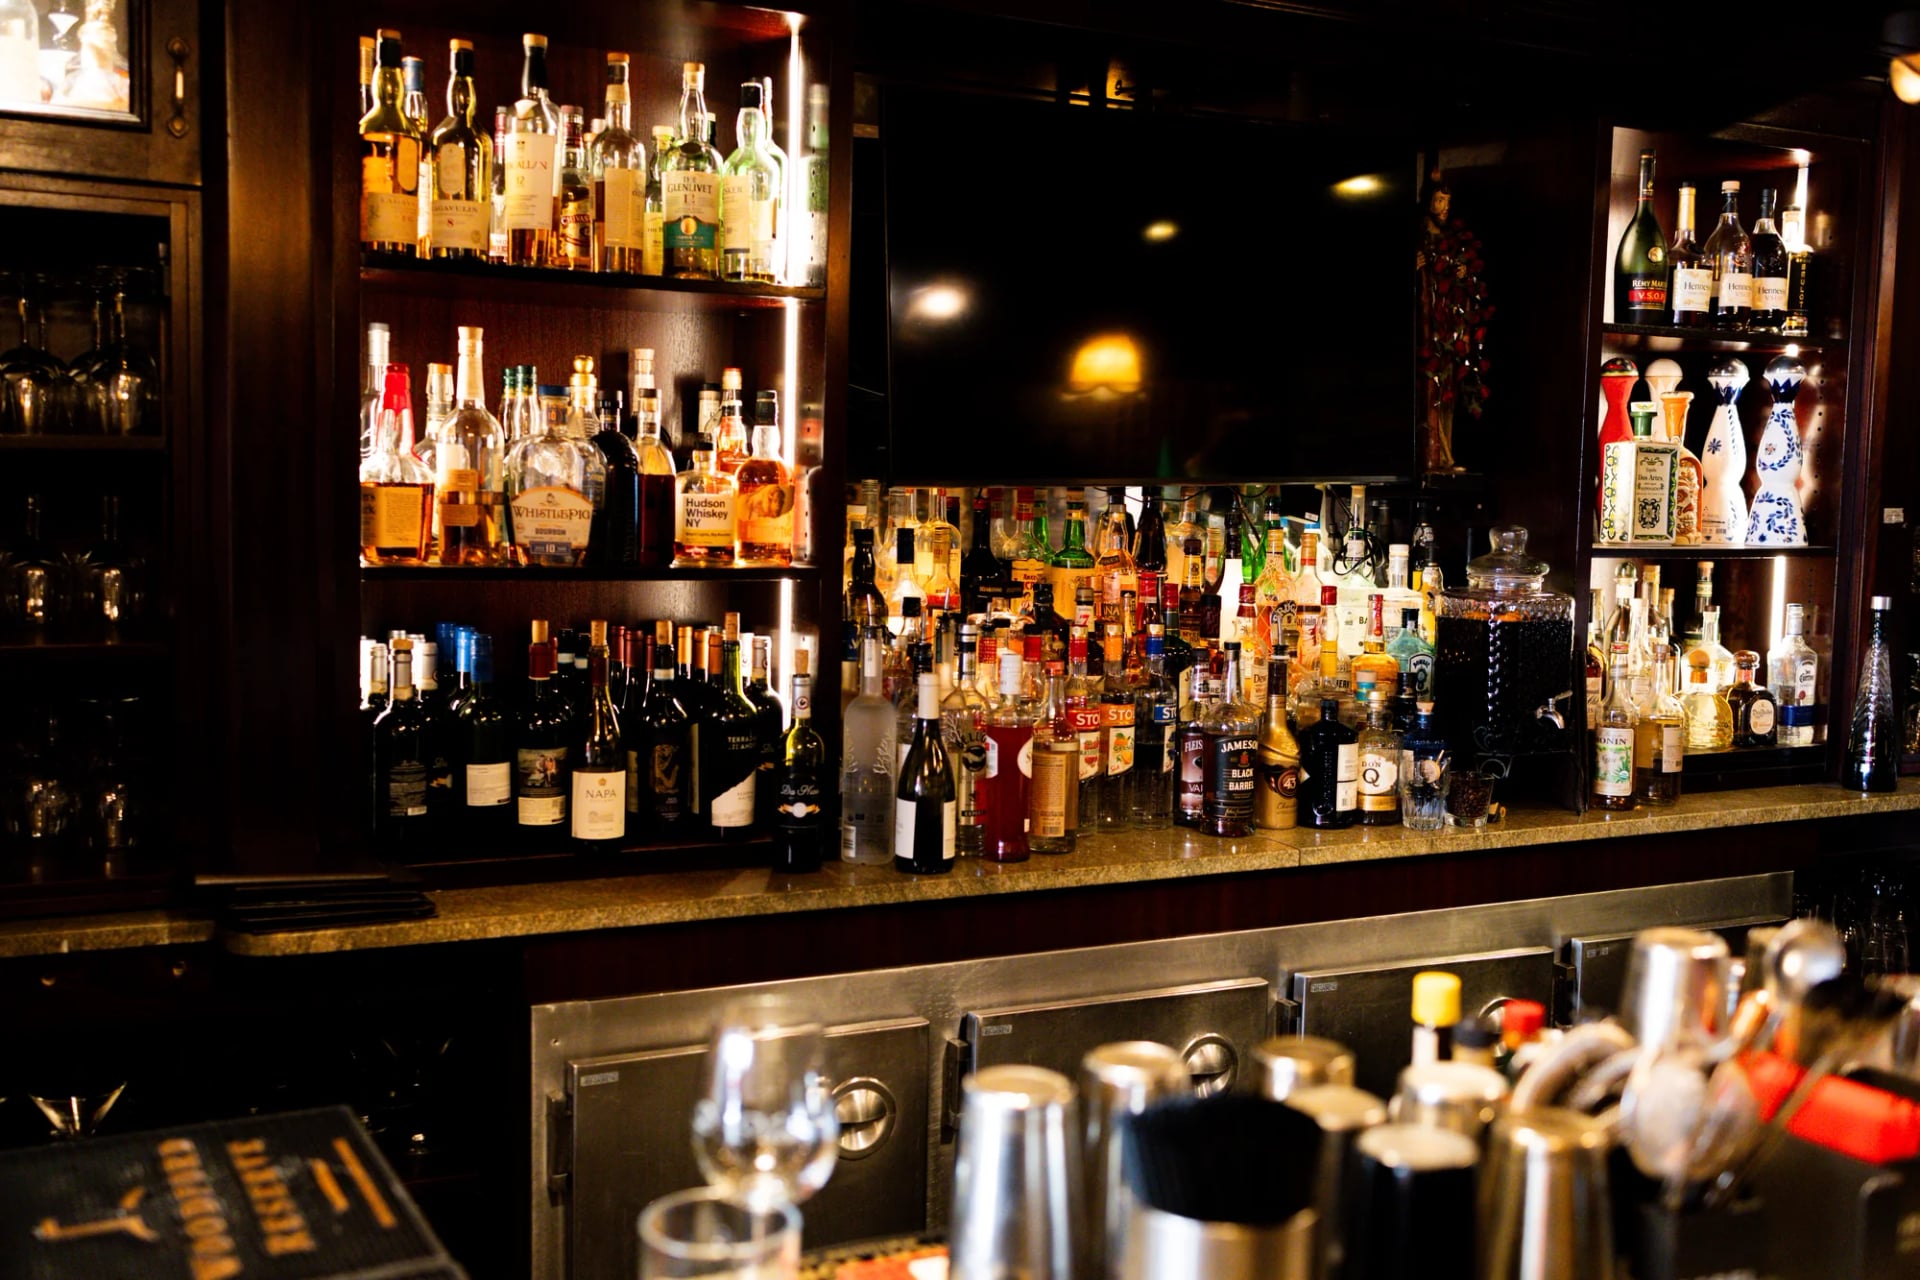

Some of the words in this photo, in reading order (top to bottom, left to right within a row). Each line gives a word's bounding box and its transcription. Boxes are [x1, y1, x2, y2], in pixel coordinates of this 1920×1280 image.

[667, 184, 712, 195] GLENLIVET
[685, 498, 726, 509] Hudson
[512, 505, 591, 520] WHISTLEPIG
[685, 508, 729, 520] Whiskey
[685, 519, 702, 528] NY
[545, 543, 556, 553] 10
[1076, 713, 1099, 726] STO
[1184, 740, 1203, 752] FLEIS
[1600, 737, 1627, 746] ONIN
[1361, 760, 1382, 768] DON
[1231, 768, 1254, 778] BLACK
[1362, 768, 1380, 787] Q
[1228, 781, 1254, 791] BARREL
[1283, 778, 1297, 790] 43
[585, 789, 617, 799] NAPA
